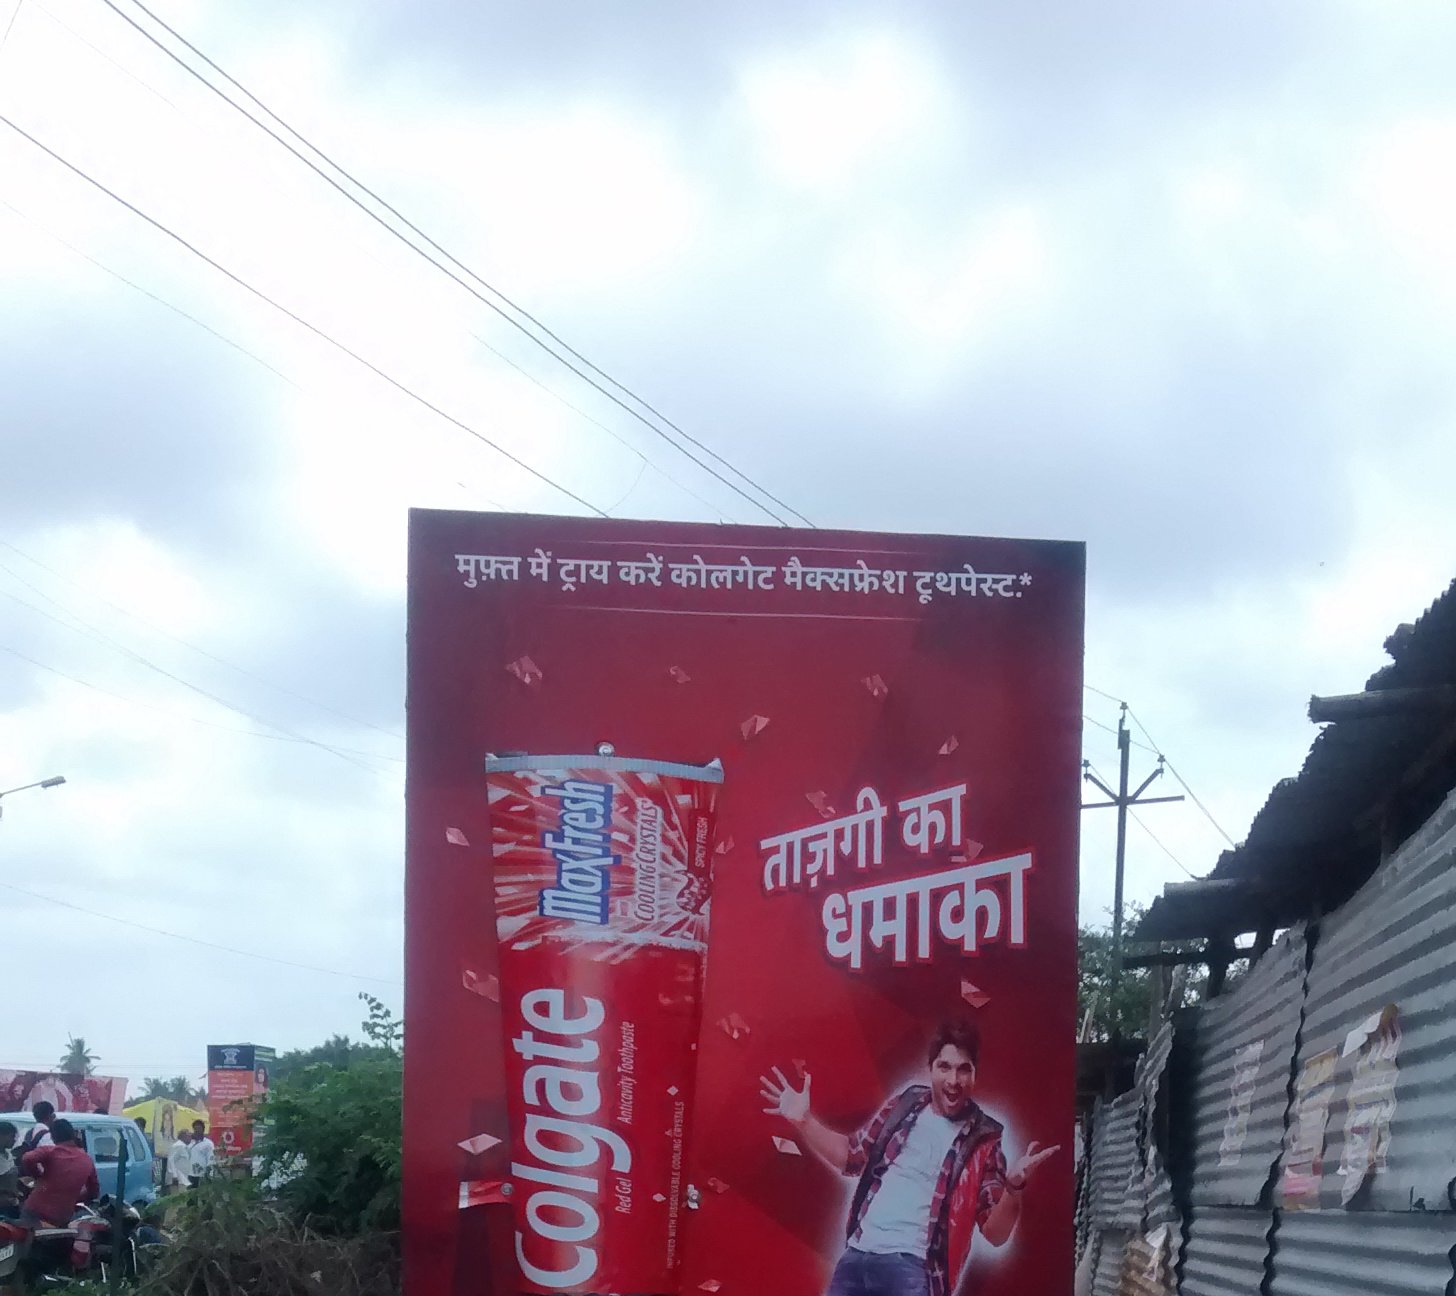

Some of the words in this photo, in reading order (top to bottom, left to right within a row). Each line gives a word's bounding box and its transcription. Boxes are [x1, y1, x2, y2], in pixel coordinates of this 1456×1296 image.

[455, 554, 522, 588] मुफ़्त
[527, 548, 552, 582] में
[557, 558, 611, 591] ट्राय
[617, 553, 663, 587] करें
[668, 554, 776, 590] कोलगेट
[782, 556, 907, 594] मैक्सफ्रेश
[540, 779, 619, 925] MaxFresh
[695, 815, 708, 843] FRESH
[760, 786, 888, 891] ताज़गी
[898, 783, 967, 854] का
[694, 843, 707, 868] SPICY
[822, 852, 1032, 968] धमाका
[617, 1021, 638, 1074] Toothpaste
[617, 1075, 637, 1124] Anticavity
[673, 1100, 685, 1138] CRYSTALS
[511, 988, 632, 1288] Colgate
[672, 1139, 683, 1170] COOLING
[615, 1195, 631, 1214] Red
[616, 1177, 632, 1194] Gel
[669, 1171, 681, 1218] DISSOLVABLE
[667, 1219, 678, 1238] WITH
